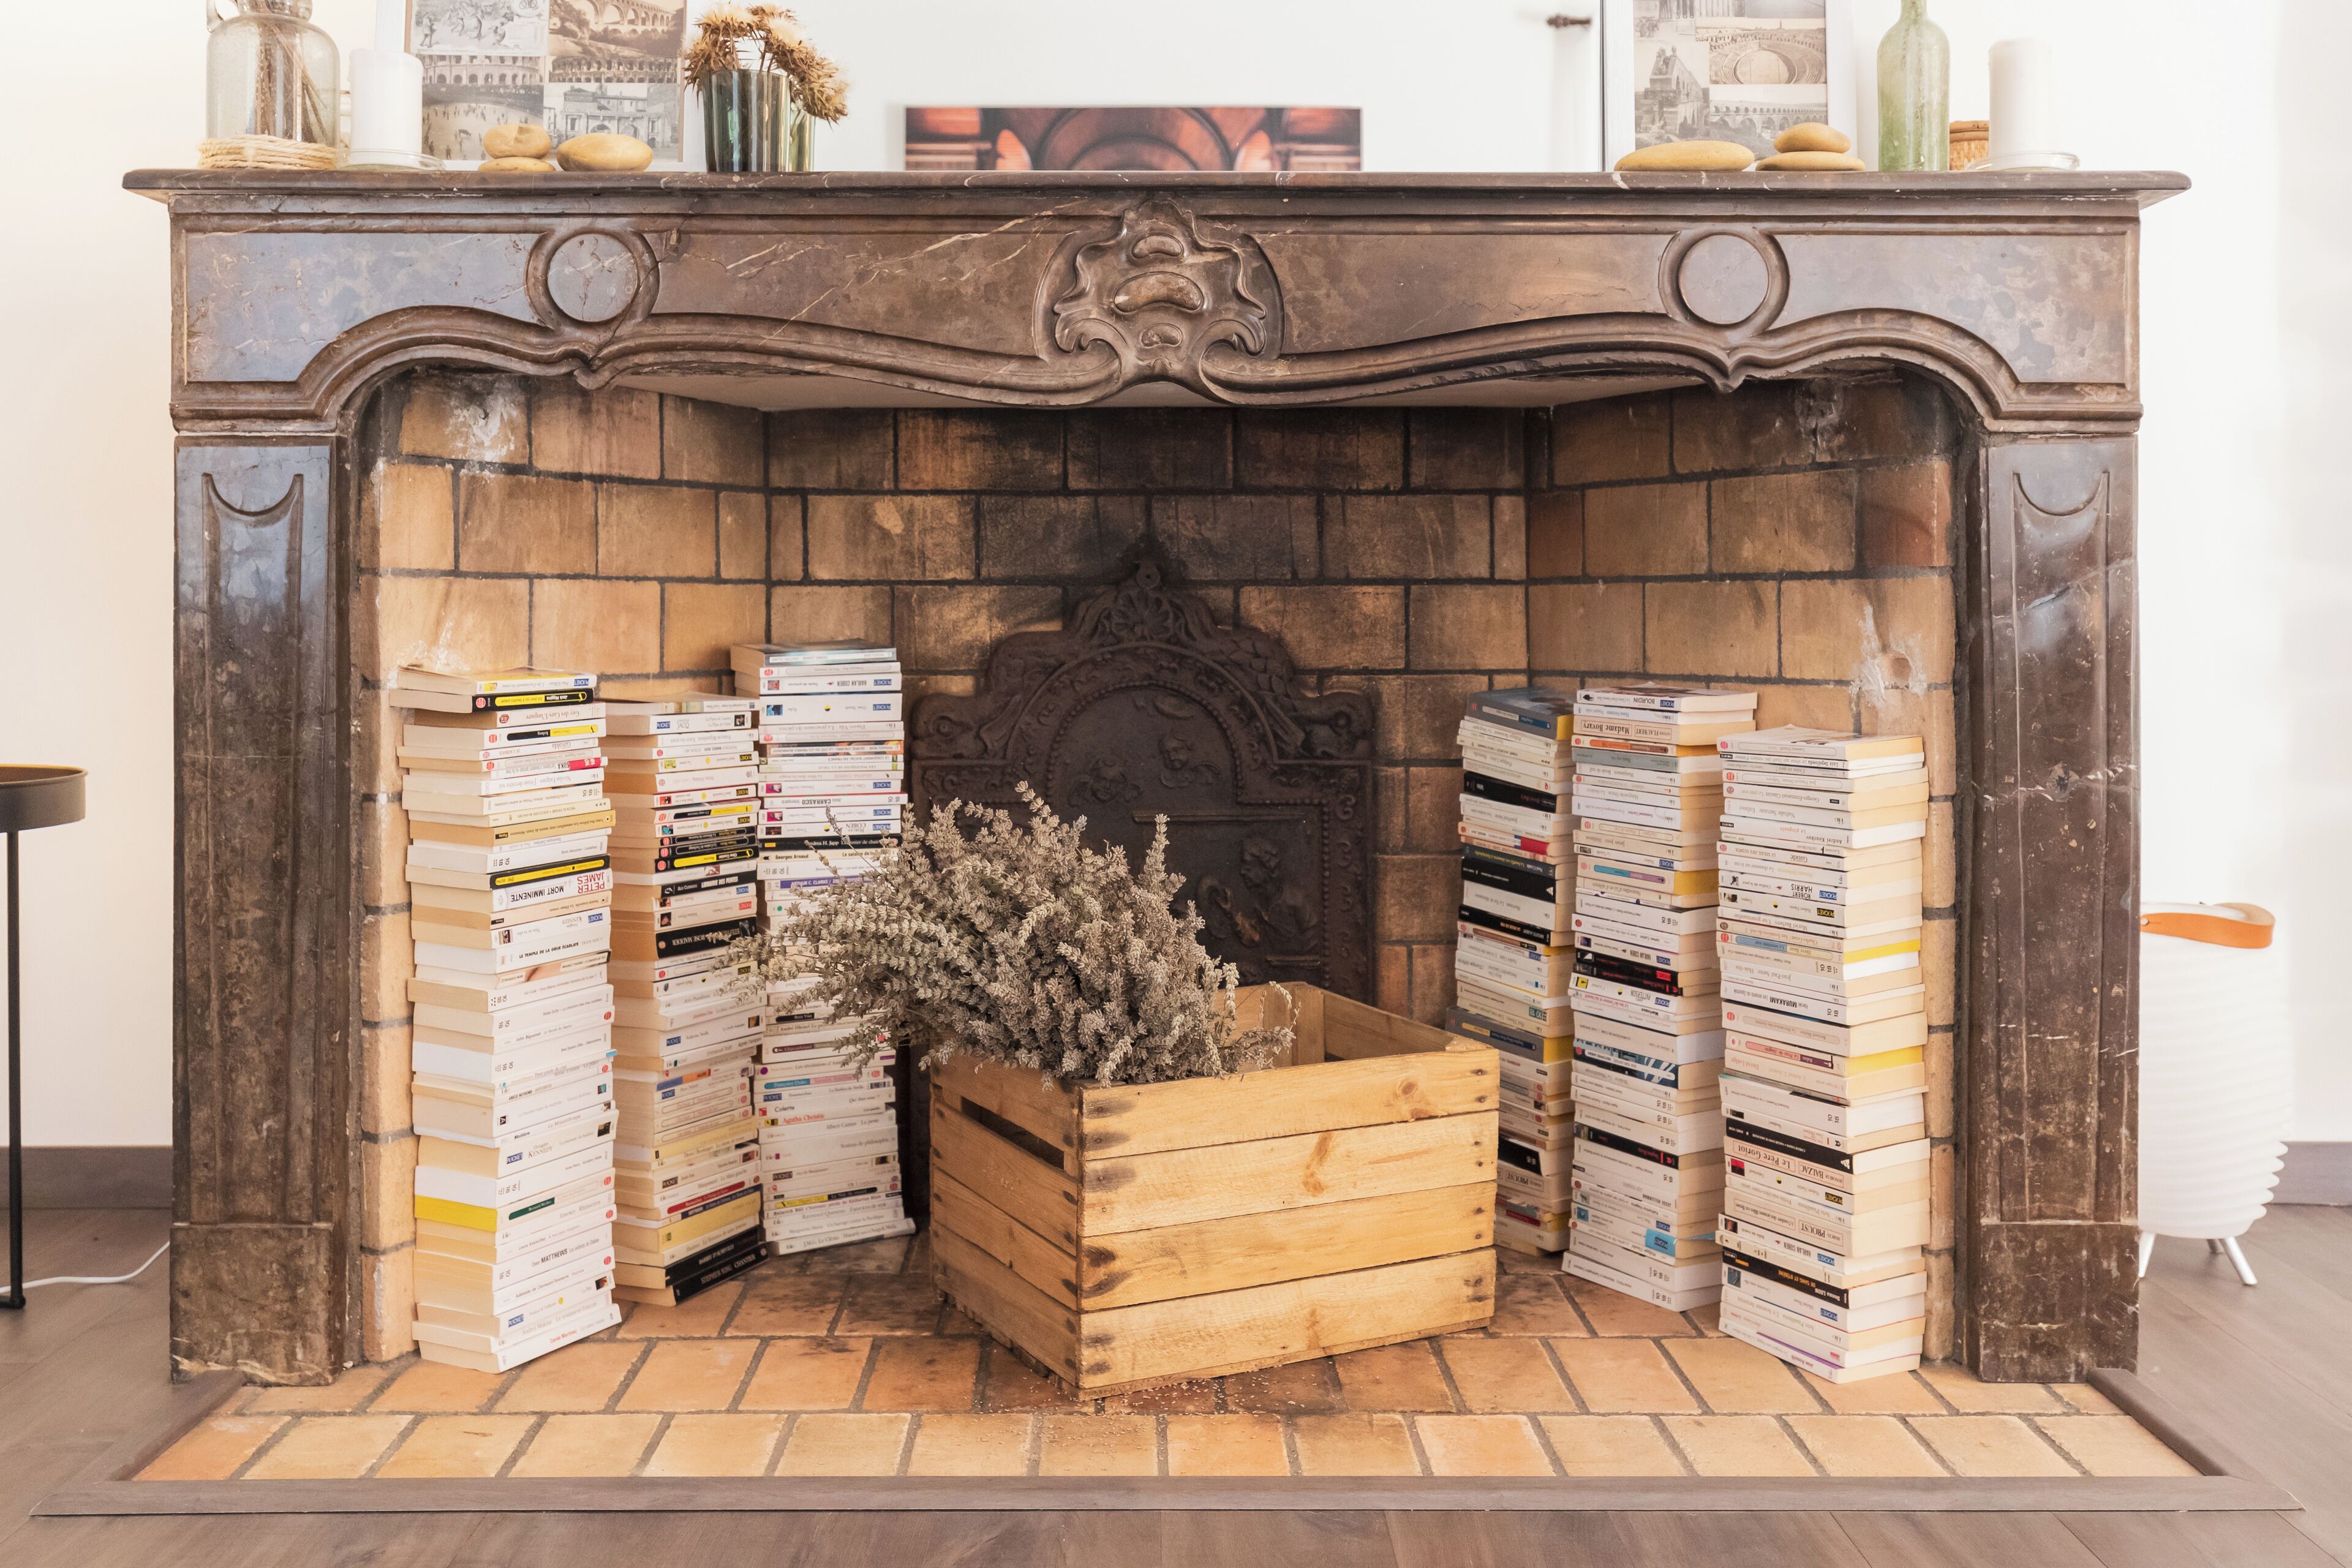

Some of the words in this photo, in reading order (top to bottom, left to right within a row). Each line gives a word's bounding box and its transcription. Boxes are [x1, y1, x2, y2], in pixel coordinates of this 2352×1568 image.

[1583, 720, 1603, 731] Bovary
[1605, 725, 1629, 734] Madame
[1635, 727, 1659, 737] FLAUBERT
[576, 872, 605, 884] JAMES
[546, 885, 564, 895] MORT
[577, 881, 605, 894] PETER
[1790, 883, 1812, 893] HARRIS
[511, 889, 545, 902] IMMINENTE
[1792, 890, 1811, 900] ROBERT
[1770, 996, 1797, 1008] MURAKAMI
[1738, 1145, 1760, 1159] Goriot
[1763, 1153, 1779, 1166] Père
[1782, 1159, 1790, 1169] Le
[1800, 1165, 1823, 1180] BALZAC
[1800, 1223, 1825, 1238] PROUST
[540, 1248, 568, 1264] MATTHEWS
